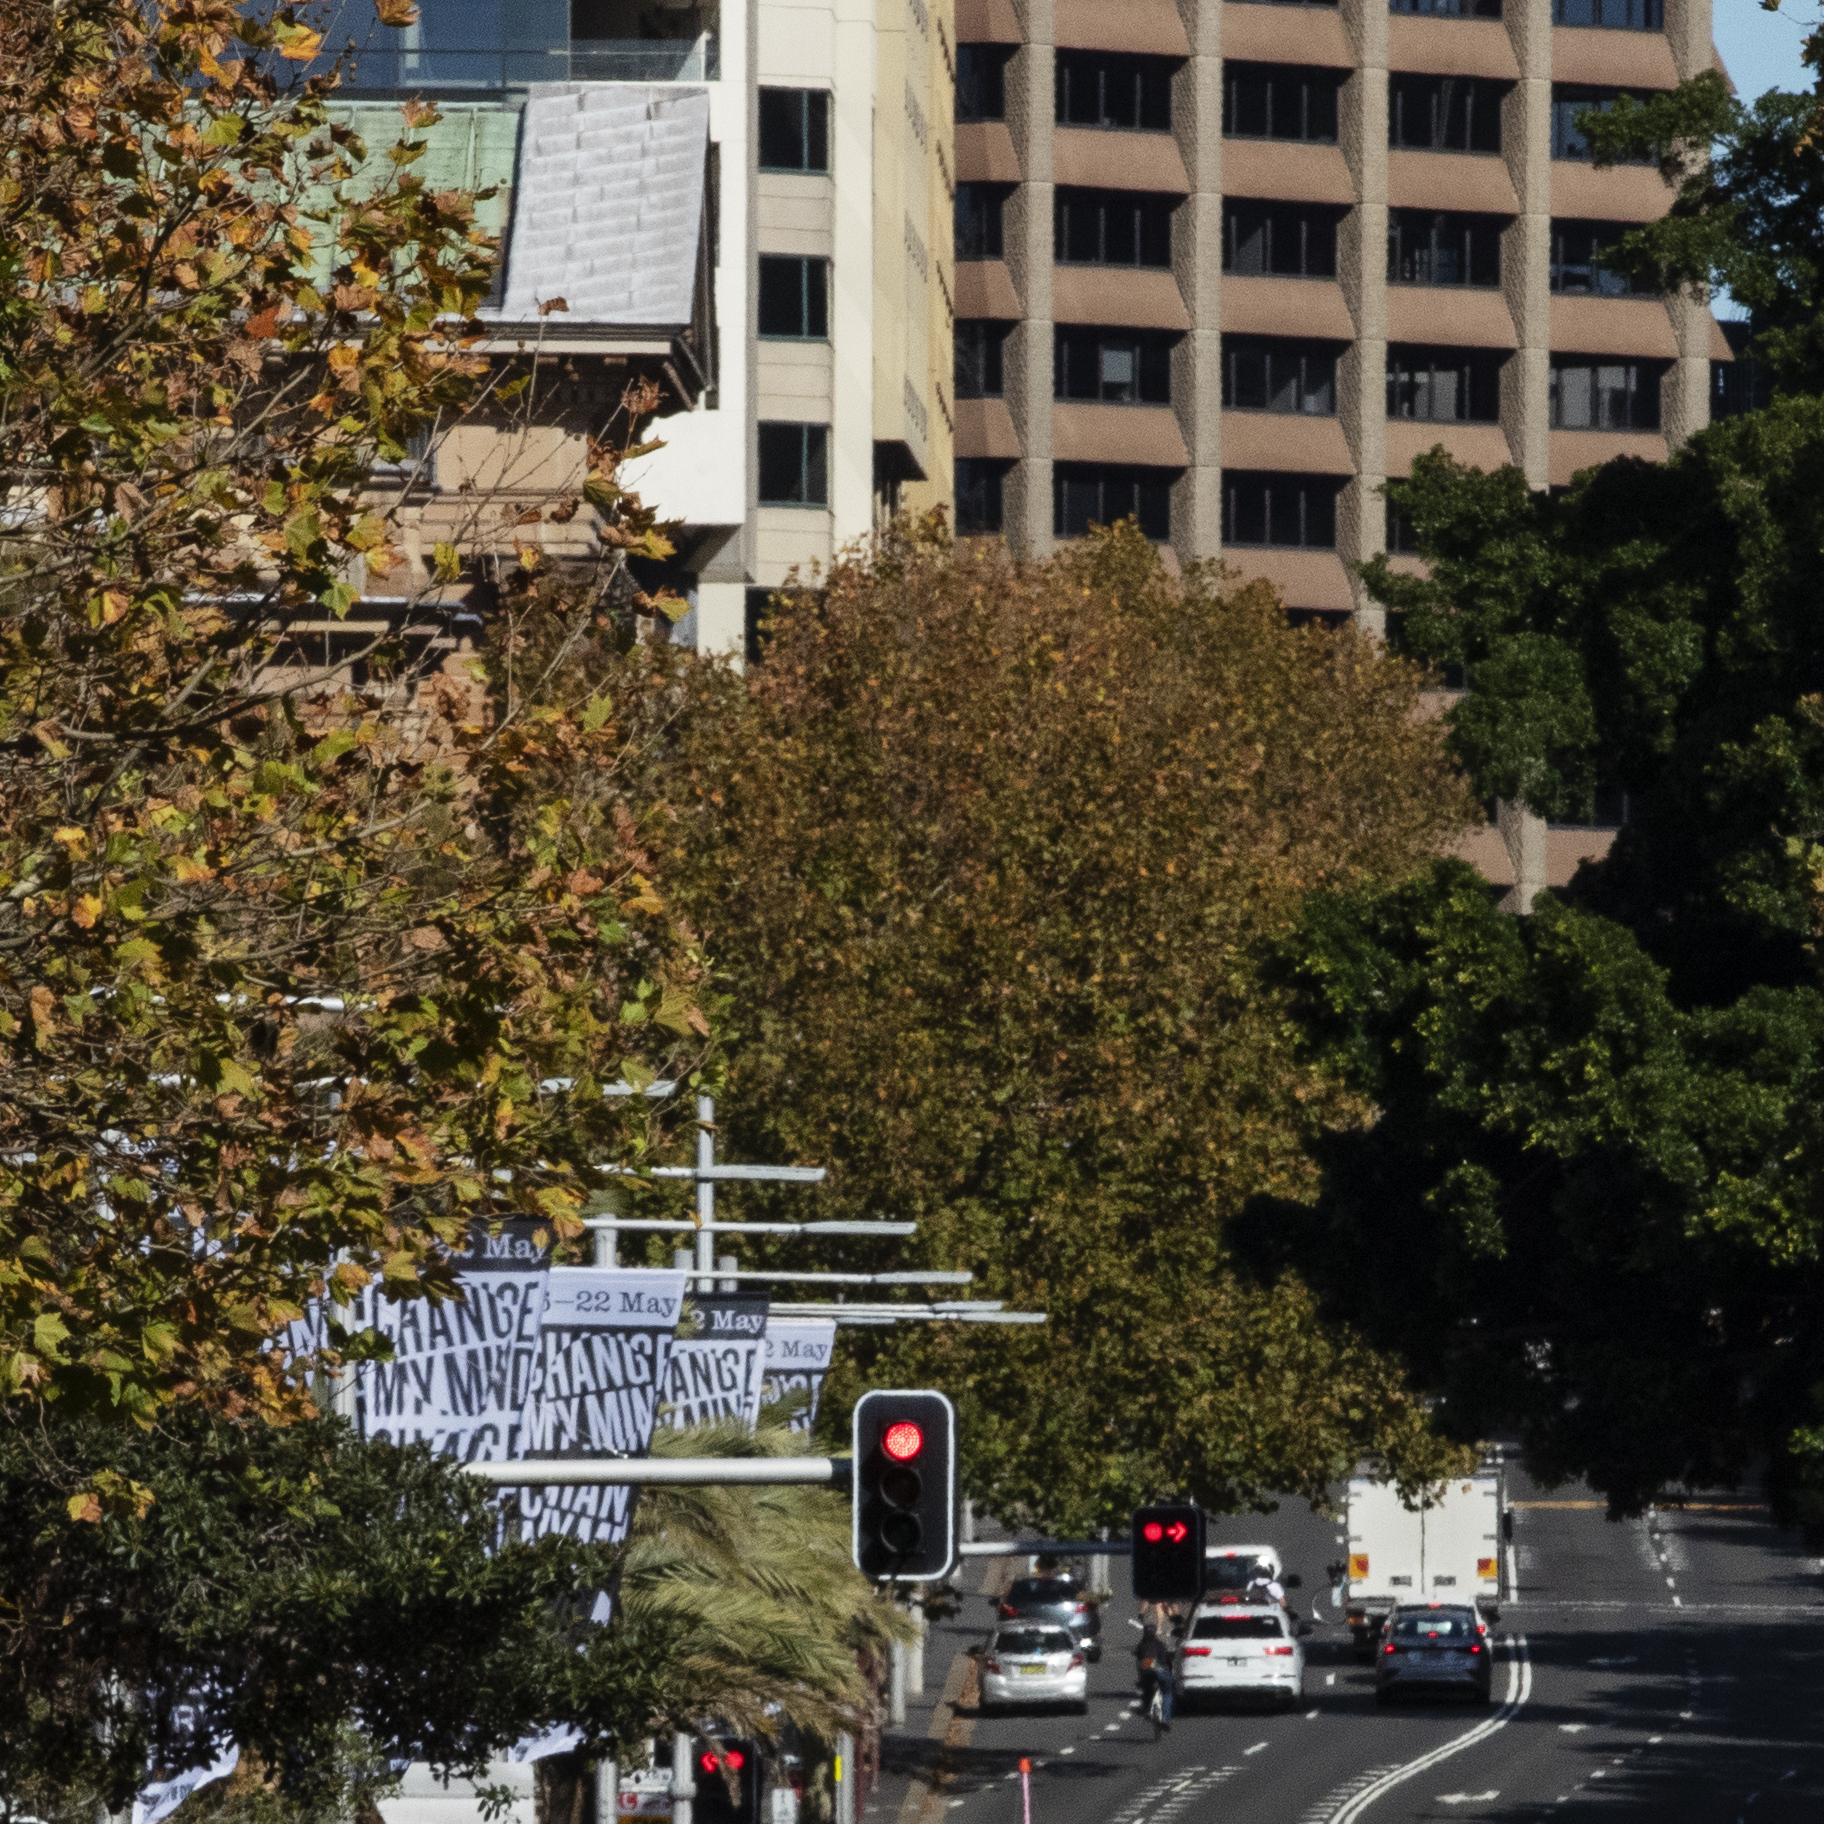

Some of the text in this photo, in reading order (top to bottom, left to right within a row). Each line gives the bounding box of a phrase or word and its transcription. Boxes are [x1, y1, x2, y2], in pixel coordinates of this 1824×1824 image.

[618, 1291, 678, 1318] May
[711, 1310, 764, 1334] May
[780, 1339, 827, 1360] May
